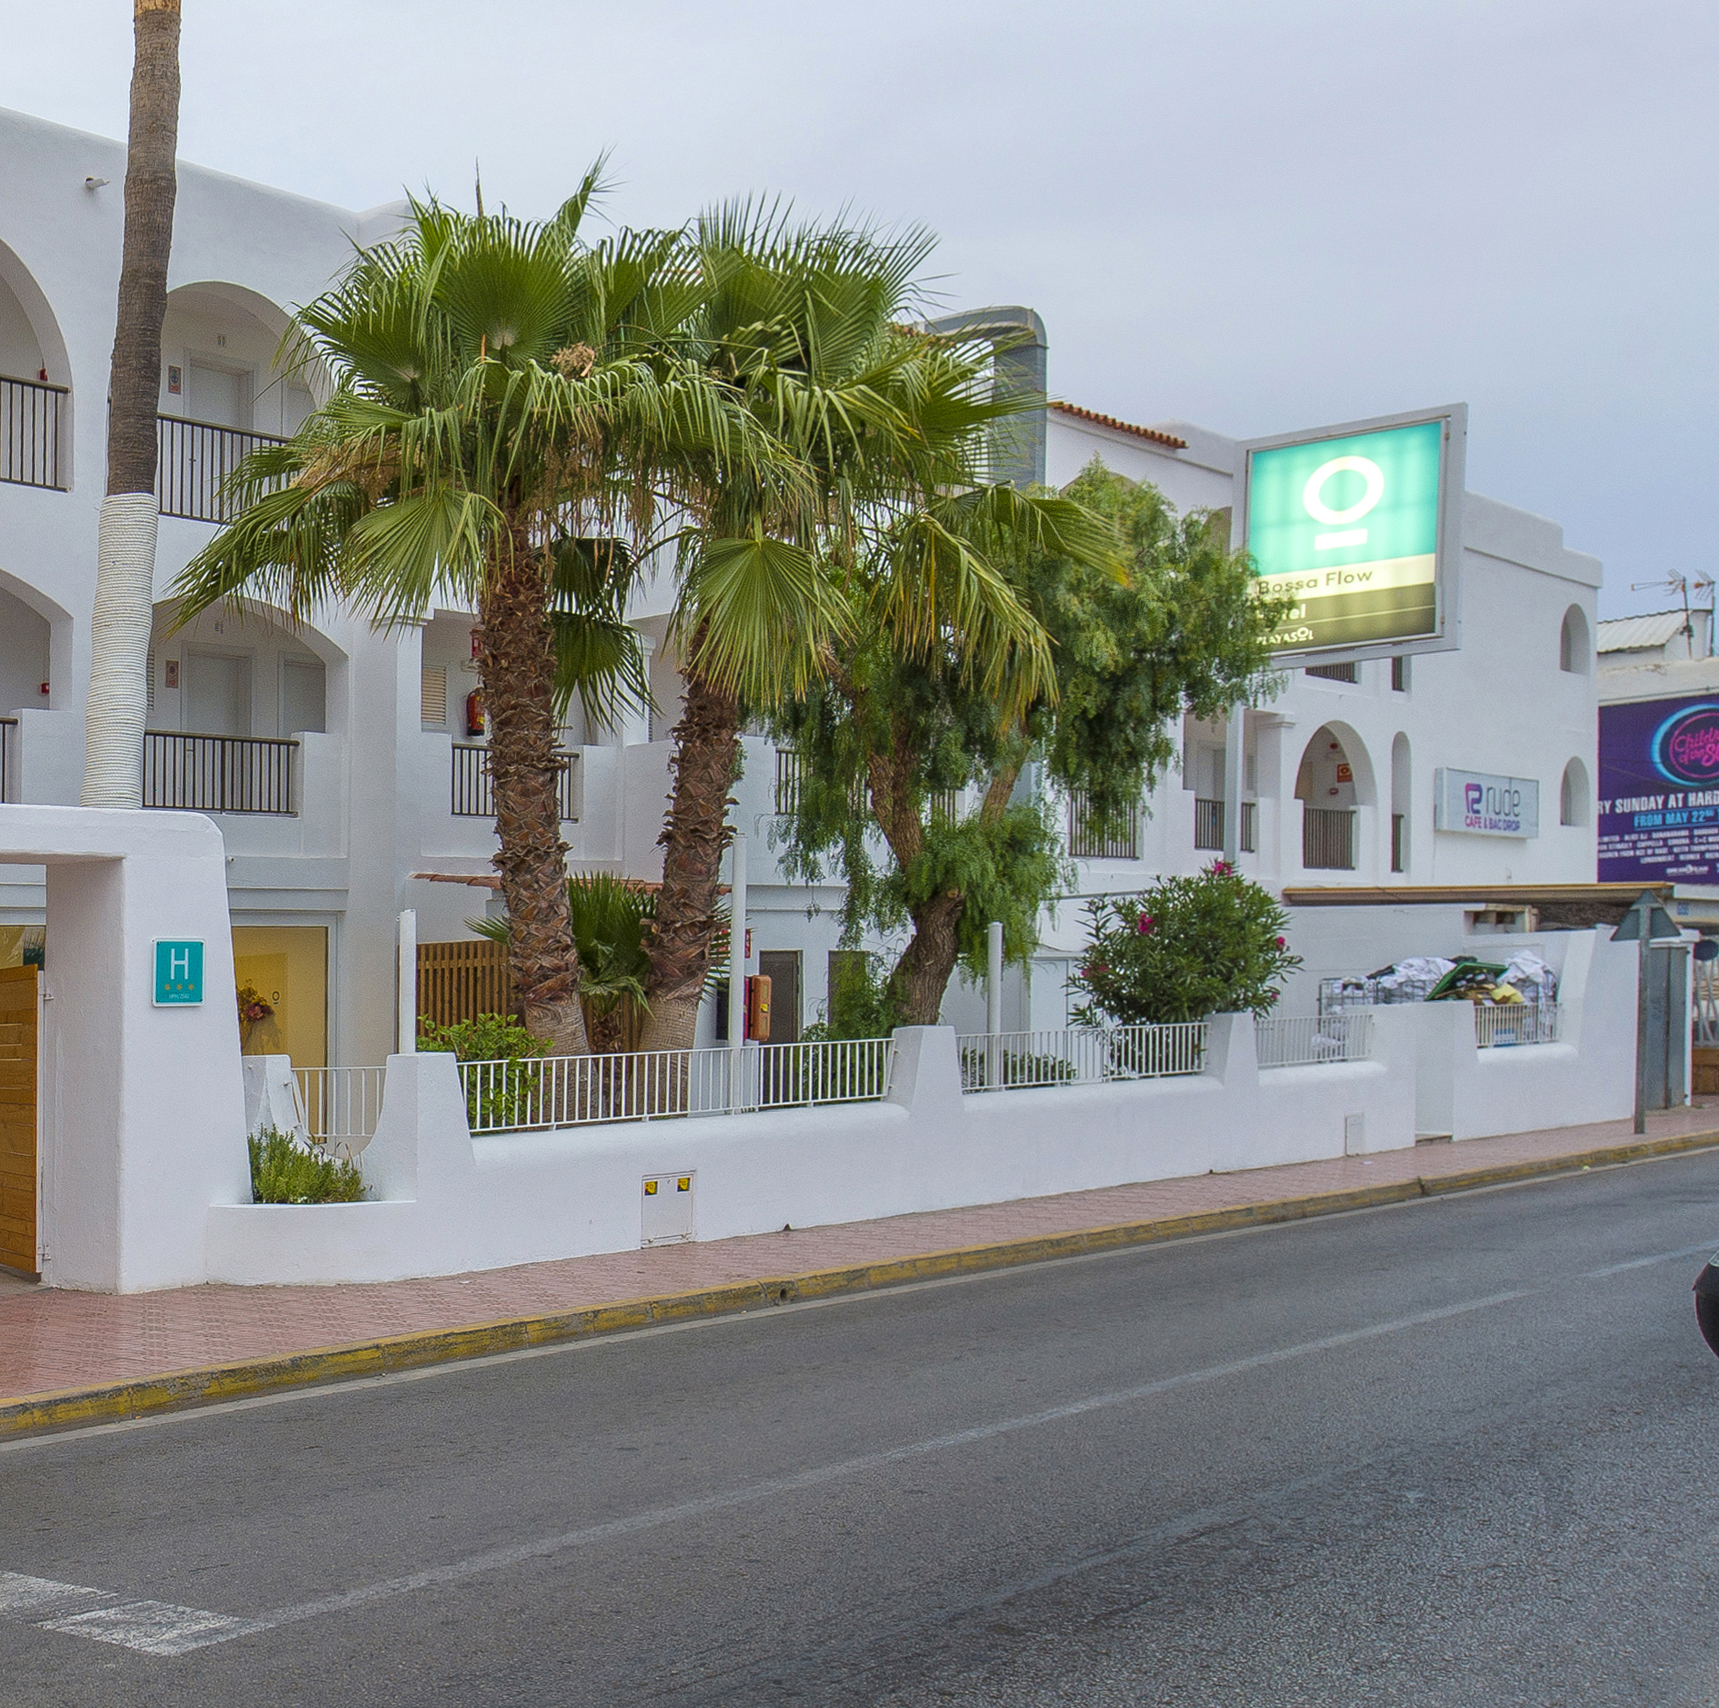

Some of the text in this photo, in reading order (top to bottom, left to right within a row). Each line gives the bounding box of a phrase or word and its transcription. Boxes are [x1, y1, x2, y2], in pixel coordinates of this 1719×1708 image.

[1258, 571, 1373, 594] Bossa Flow
[1256, 627, 1314, 645] PLAYASOL
[1486, 786, 1521, 818] rude
[1615, 794, 1665, 814] SUNDAY
[1667, 793, 1685, 809] AT
[1465, 815, 1482, 829] CAFE
[1634, 813, 1663, 828] FROM
[1665, 811, 1689, 825] MAY
[170, 948, 189, 980] H
